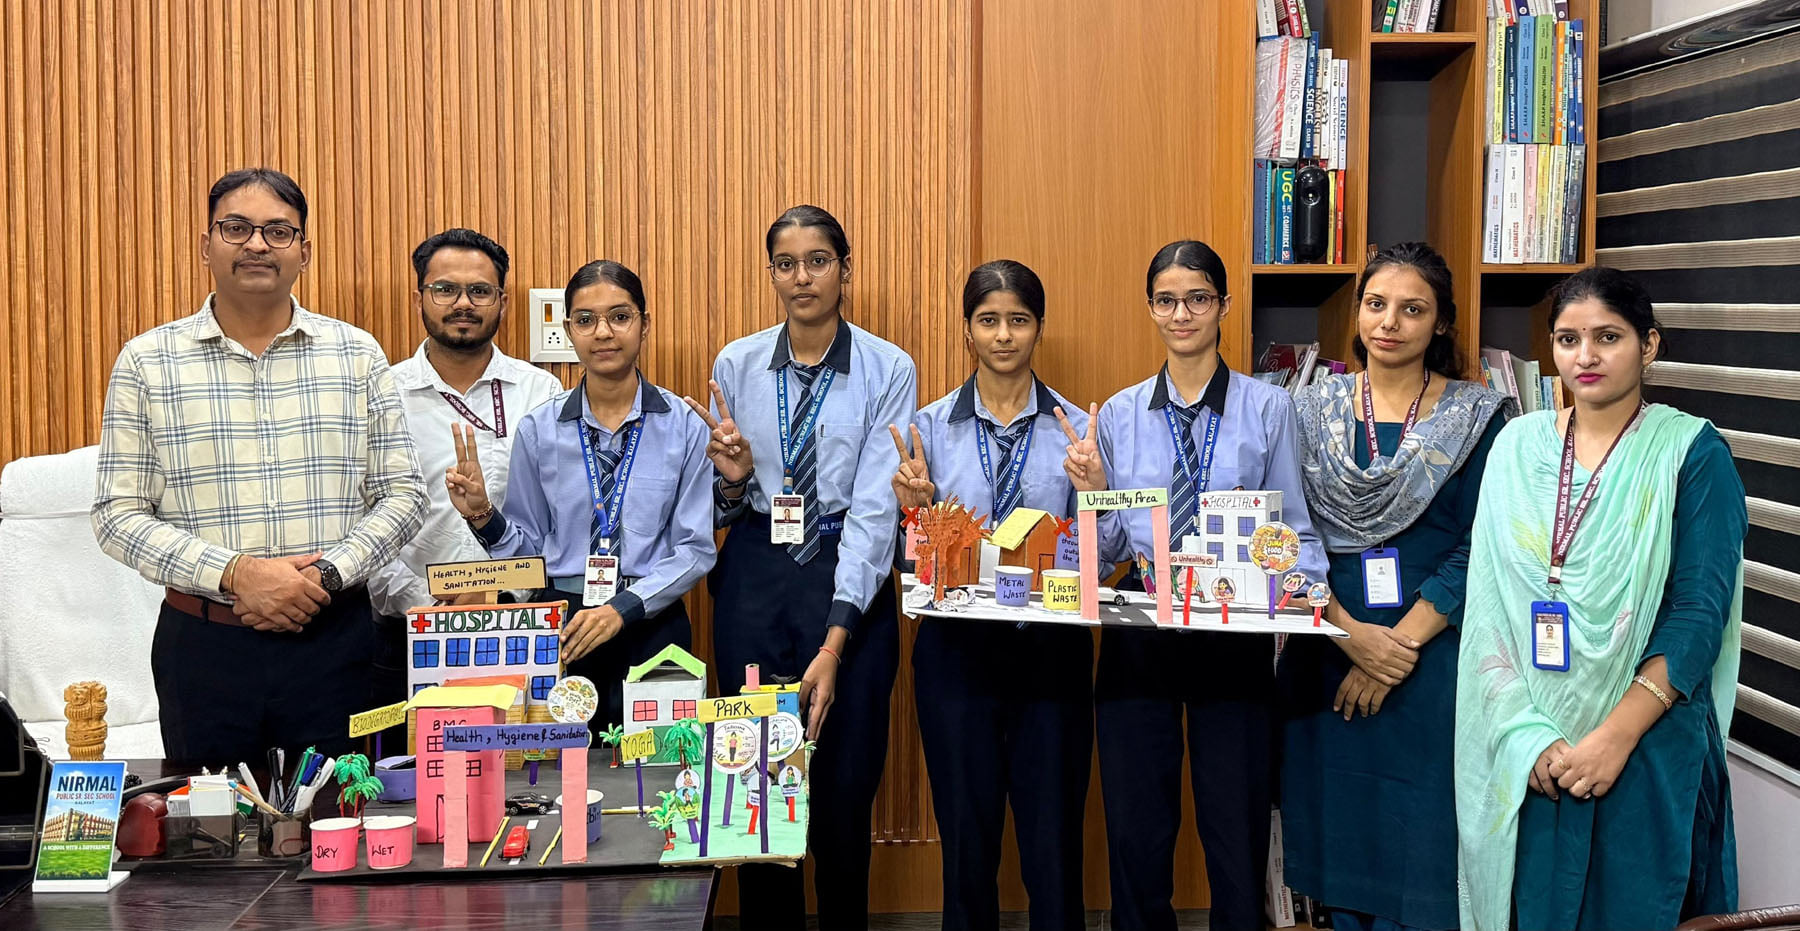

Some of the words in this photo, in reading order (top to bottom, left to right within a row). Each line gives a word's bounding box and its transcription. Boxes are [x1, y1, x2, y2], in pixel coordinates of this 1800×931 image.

[1290, 63, 1302, 100] PHYSICS
[1305, 88, 1315, 124] SCIENCE
[1281, 171, 1292, 202] UGC
[1208, 416, 1216, 442] KALAYAT
[789, 443, 799, 465] NIRMAL
[798, 423, 808, 444] PUBLIC
[1176, 433, 1184, 454] PUBLIC
[588, 454, 596, 476] PUBLIC
[609, 503, 618, 525] PUBLIC
[628, 429, 638, 456] KALAYAT
[1007, 470, 1016, 492] PUBLIC
[592, 476, 600, 499] NIRMAL
[1086, 492, 1132, 508] Unhealthy
[1135, 491, 1158, 504] Area
[1208, 496, 1253, 508] HOSPITAL
[1558, 530, 1572, 555] NIRMAL
[1570, 508, 1583, 532] PUBLIC
[1586, 483, 1595, 498] SEC.
[1267, 540, 1283, 548] JUNK
[1267, 547, 1283, 555] FOOD
[515, 562, 531, 570] AND
[1179, 556, 1205, 564] Unhealthy
[999, 577, 1025, 587] METAL
[1048, 580, 1077, 593] PLASTIC
[1003, 590, 1026, 599] WASTE
[1053, 595, 1077, 603] WASTE
[435, 608, 545, 633] HOSPITAL
[714, 699, 754, 717] PARK
[497, 729, 539, 746] Hygiene
[541, 729, 547, 743] &
[549, 727, 588, 740] Sanitation
[623, 733, 652, 760] YOGA
[57, 776, 117, 791] NIRMAL
[315, 845, 338, 859] DRY
[372, 845, 395, 857] WET
